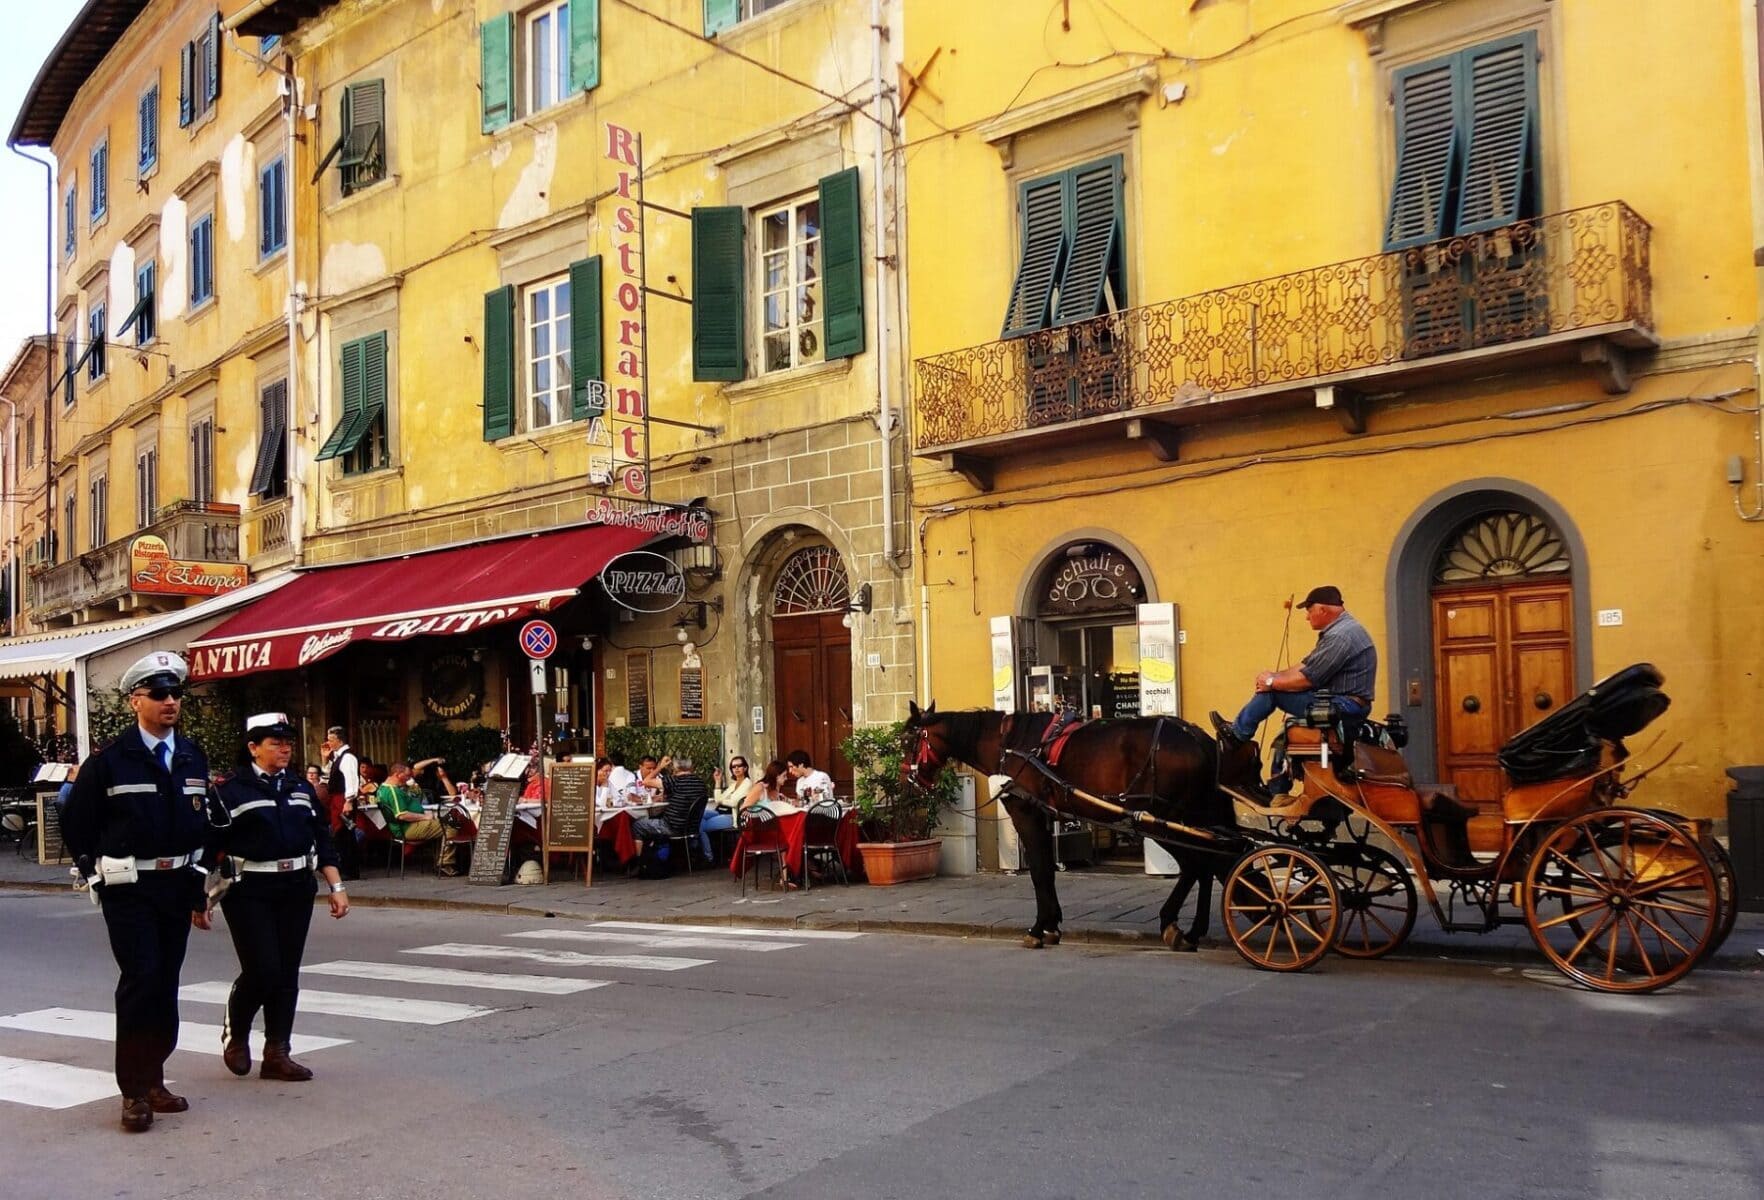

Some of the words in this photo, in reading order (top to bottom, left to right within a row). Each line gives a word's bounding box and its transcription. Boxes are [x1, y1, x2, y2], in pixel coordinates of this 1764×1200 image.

[606, 122, 647, 496] Ristorante
[586, 499, 709, 541] Antonietta
[138, 541, 165, 552] Pizzeria
[1050, 552, 1112, 602] occhiali
[1600, 612, 1621, 624] 185
[191, 641, 272, 676] ANTICA
[427, 693, 477, 717] TRATTORIA
